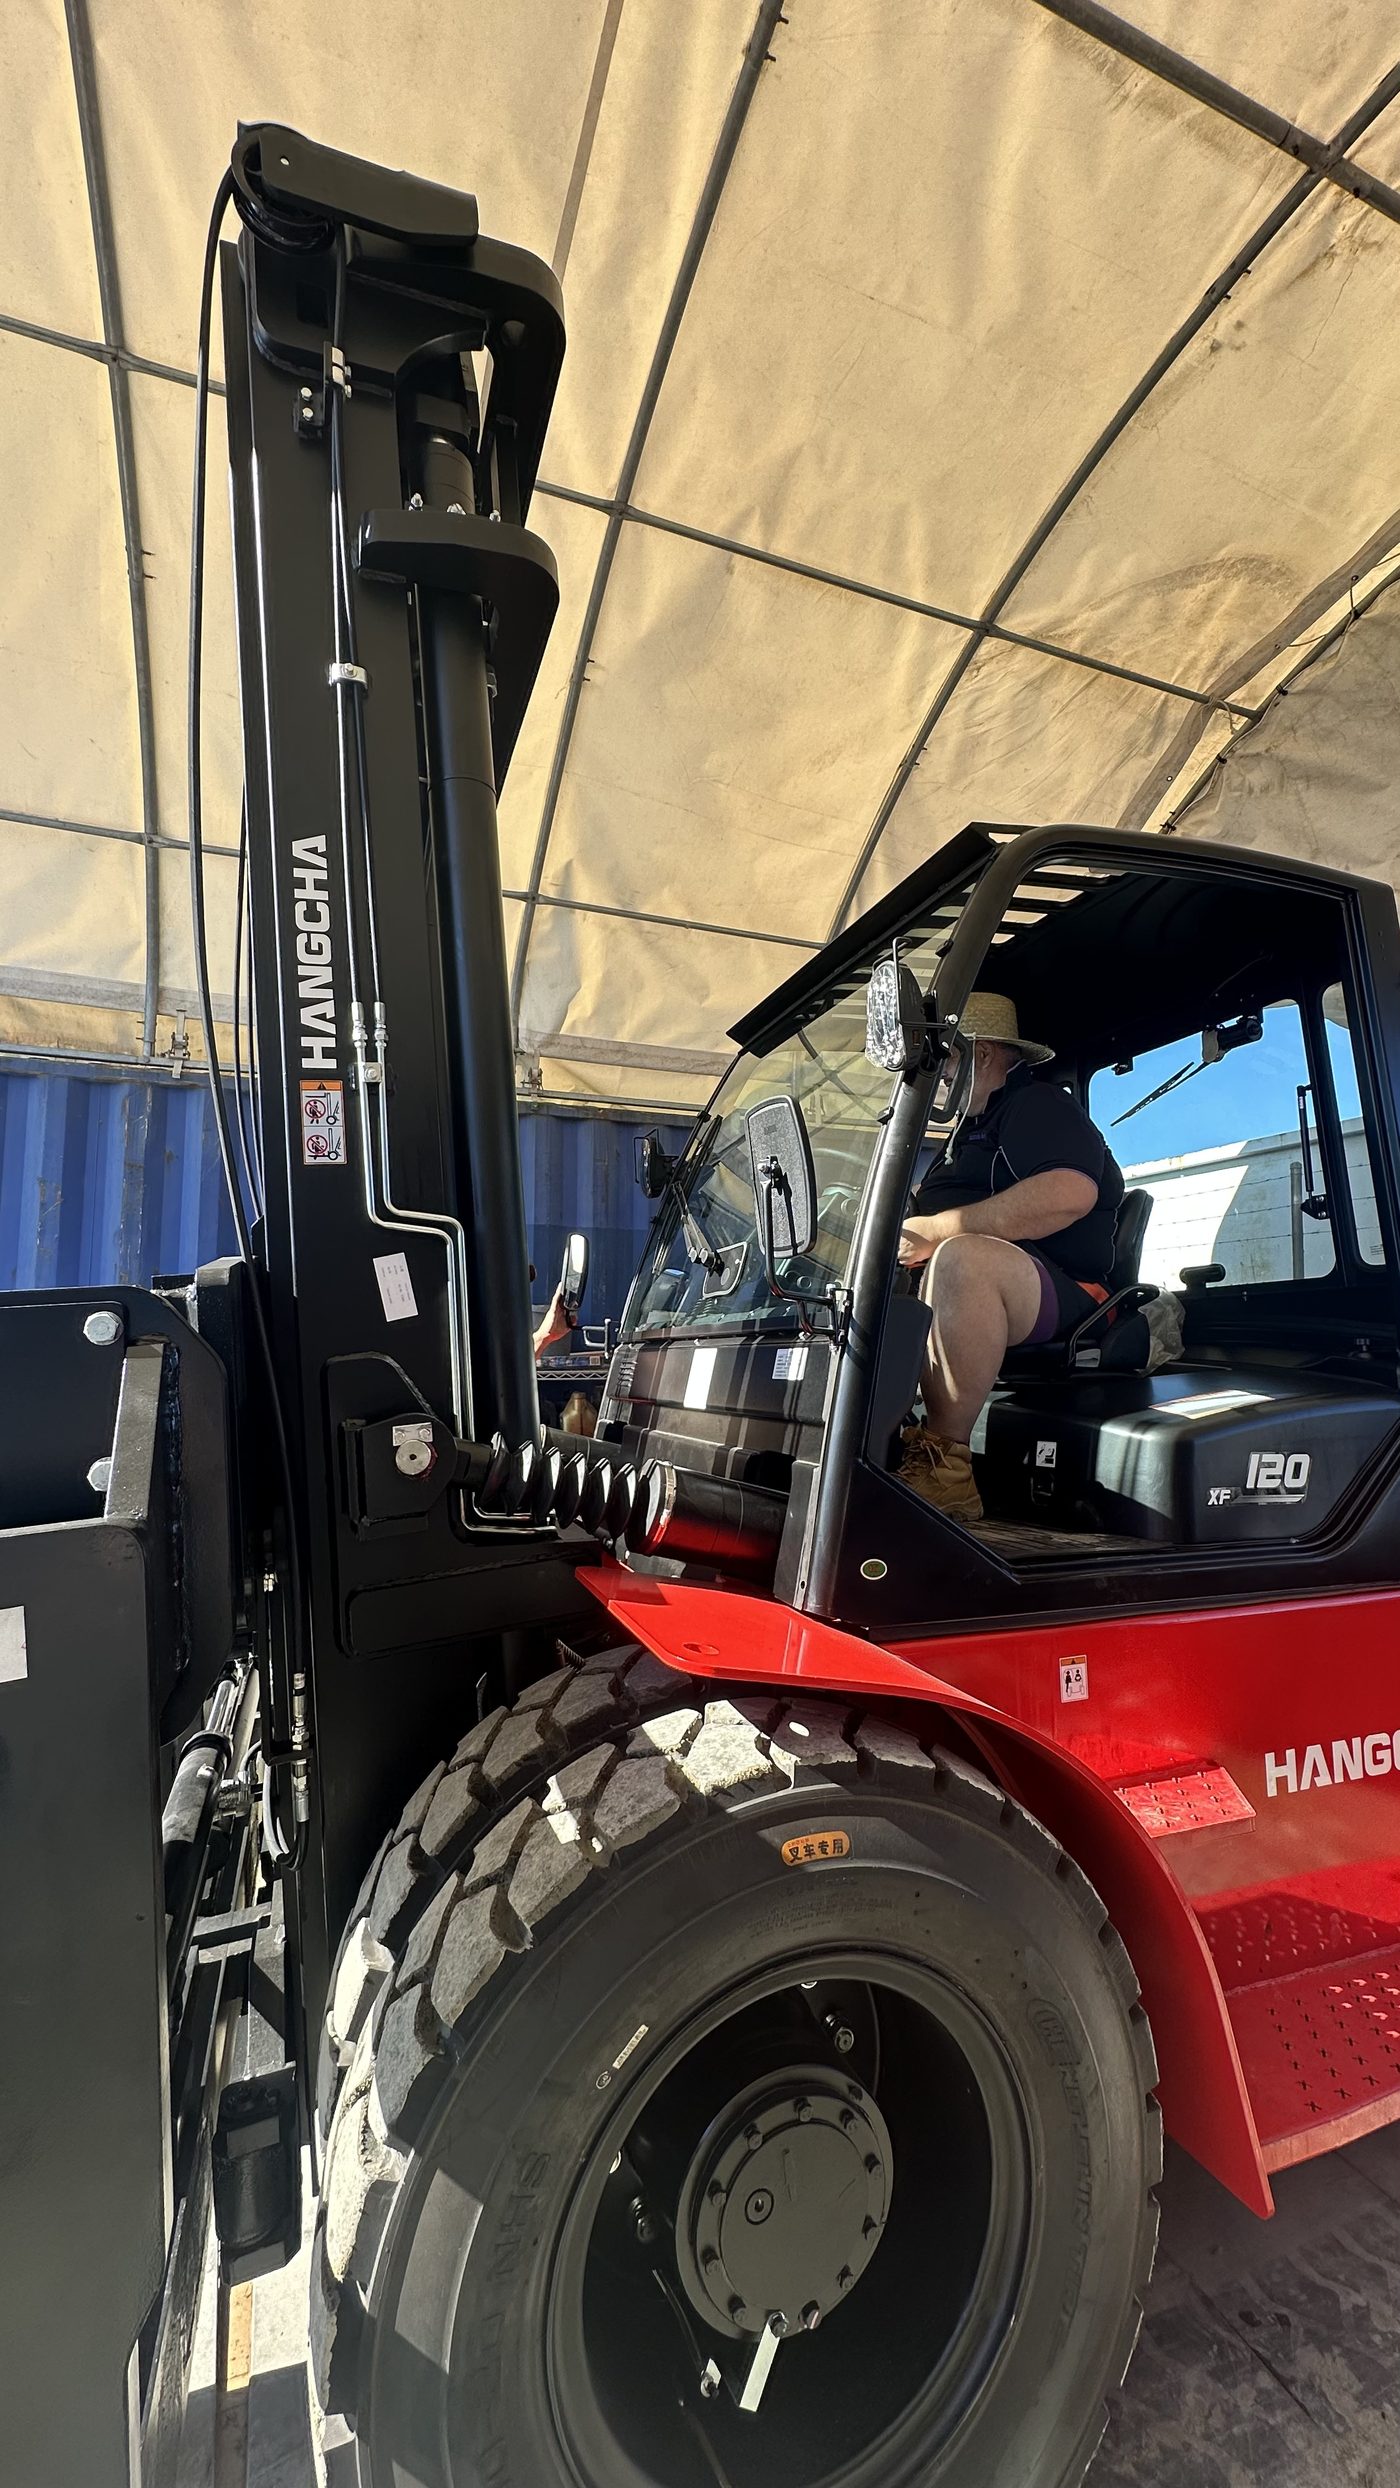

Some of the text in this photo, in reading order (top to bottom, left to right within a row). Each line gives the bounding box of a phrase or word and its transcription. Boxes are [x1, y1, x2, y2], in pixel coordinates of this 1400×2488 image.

[291, 834, 338, 1070] HANGCHA
[1246, 1453, 1310, 1489] 120
[1207, 1489, 1231, 1505] XF
[1264, 1729, 1400, 1797] HANG
[788, 1838, 845, 1864] 叉车专用
